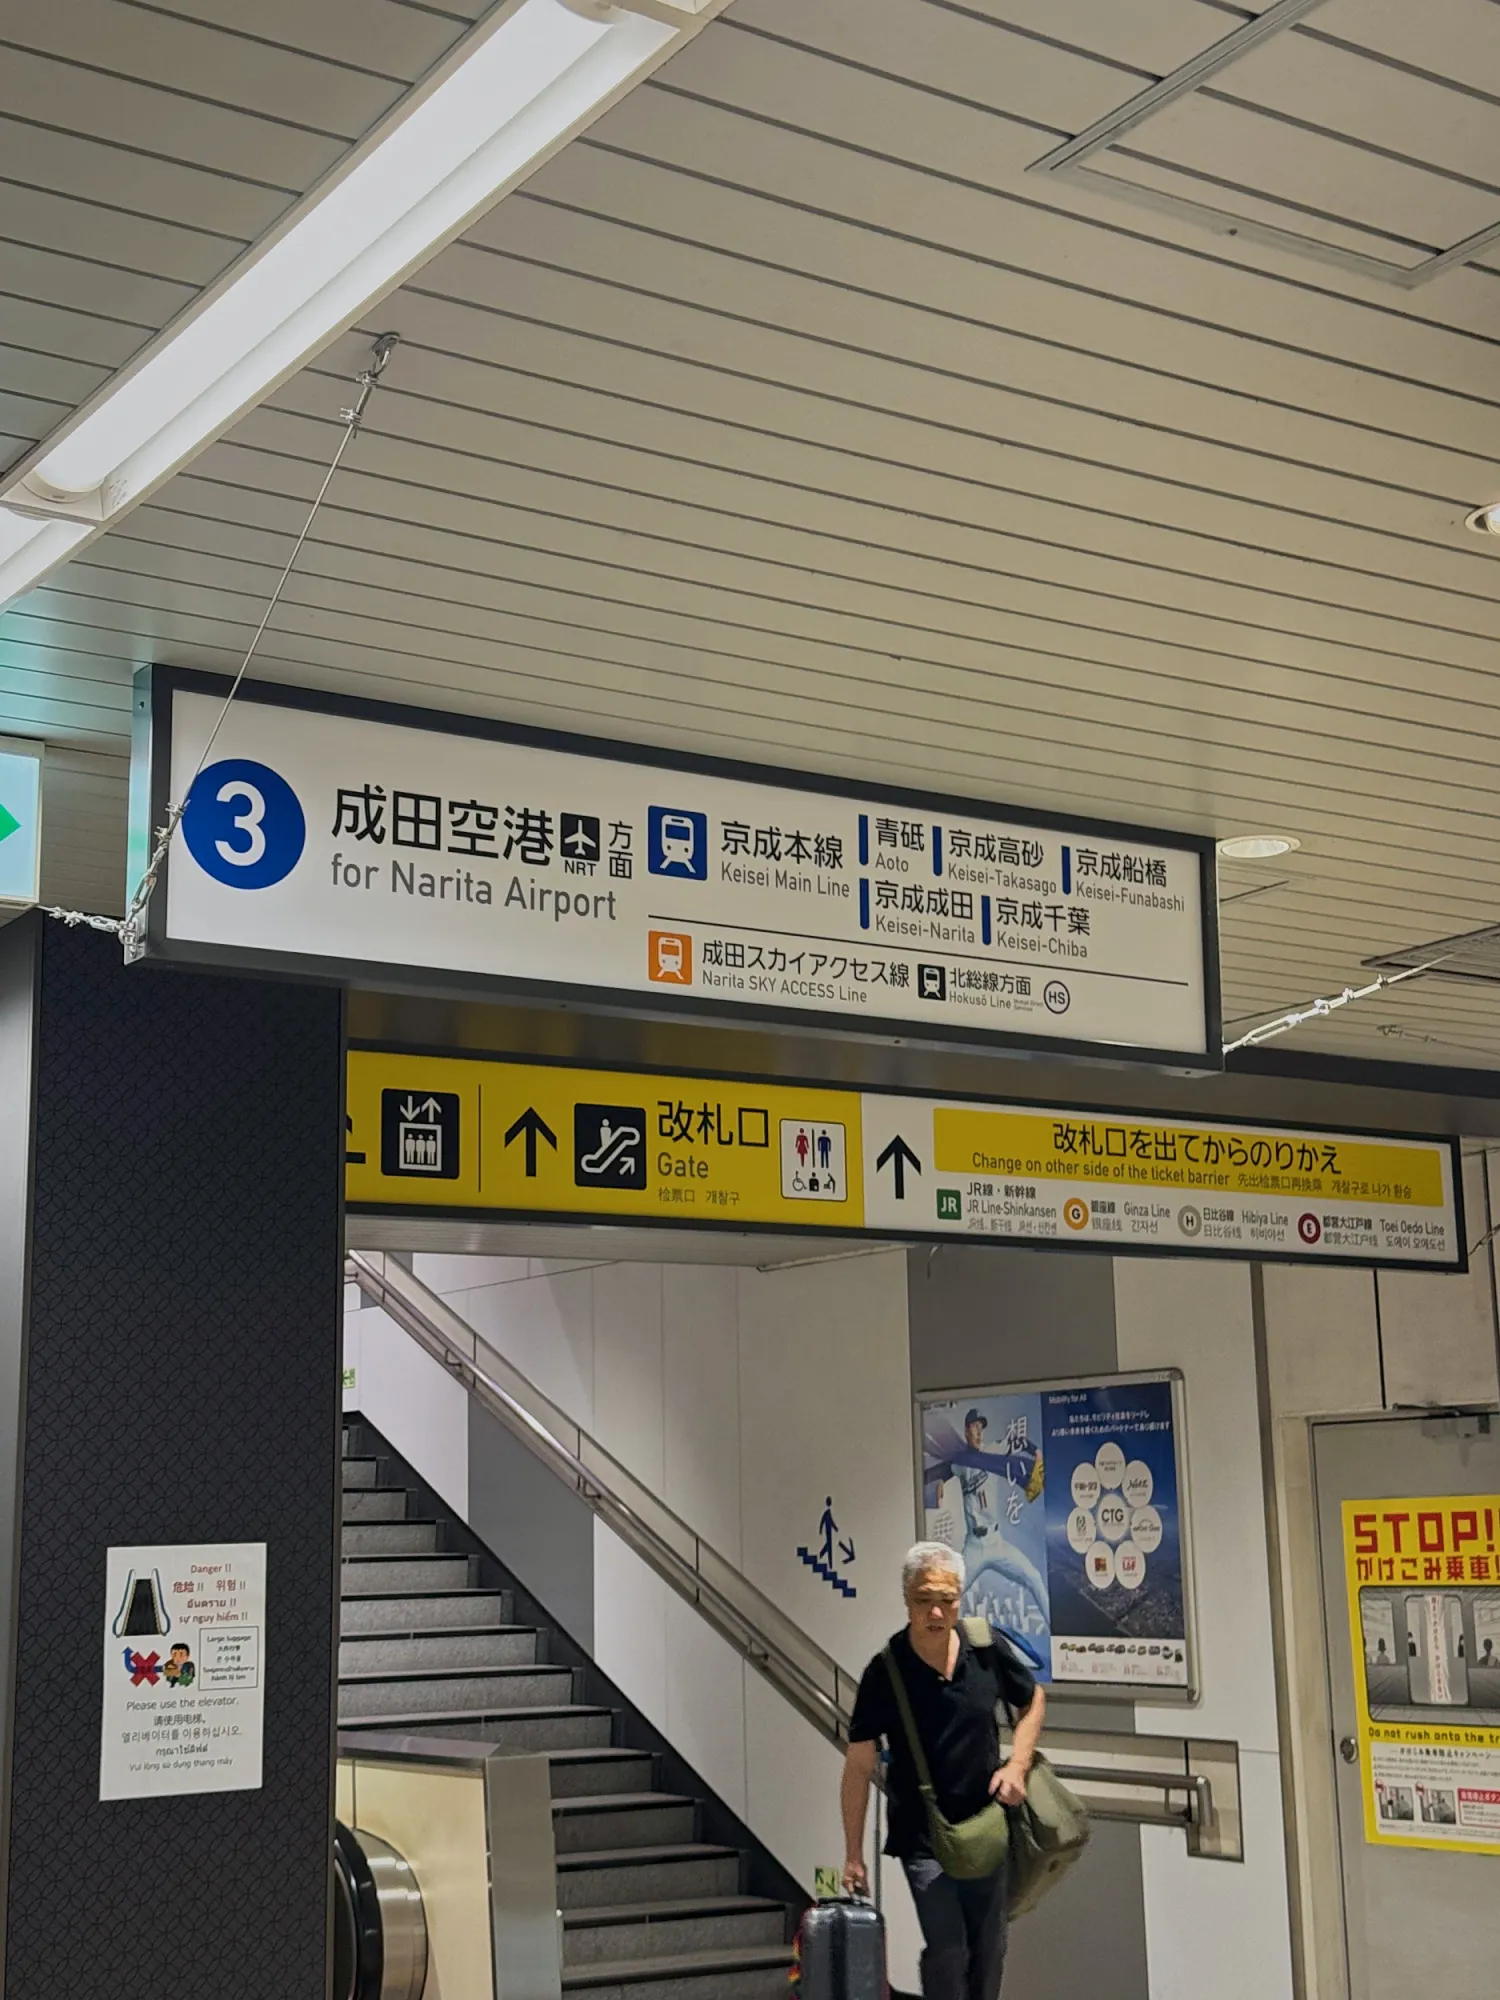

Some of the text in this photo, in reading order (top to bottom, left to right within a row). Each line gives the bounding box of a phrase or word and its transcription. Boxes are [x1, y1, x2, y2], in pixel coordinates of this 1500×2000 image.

[214, 780, 266, 866] 3
[332, 784, 554, 866] 成田空港
[875, 817, 925, 852] 青砥
[608, 820, 633, 879] 方面
[721, 821, 843, 870] 京成本線
[948, 829, 1044, 869] 京成高砂
[565, 859, 596, 877] NRT
[875, 852, 909, 872] Aoto
[1076, 847, 1167, 888] 京成船橋
[332, 853, 617, 922] for Narita Airport
[721, 861, 850, 897] Keisei Main Line
[948, 863, 1057, 896] Keisei-Takasago
[875, 880, 973, 920] 京成成田
[1076, 881, 1185, 912] Keisei-Funabashi
[875, 915, 975, 944] Keisei-Narita
[996, 897, 1090, 936] 京成千葉
[997, 931, 1087, 958] Keisei-Chiba
[702, 940, 910, 988] 成田スカイアクセス線
[702, 970, 867, 1003] Narita SKY ACCESS Line
[950, 967, 1031, 996] 北総線方面
[990, 996, 1011, 1009] Line
[1048, 991, 1066, 1005] HS
[657, 1100, 769, 1147] 改札口
[1053, 1123, 1341, 1174] 改札口を出てからのりかえ
[657, 1152, 709, 1179] Gate
[972, 1152, 1230, 1187] Change on other side of the ticket barrier
[940, 1196, 958, 1214] JR
[967, 1199, 979, 1213] JR
[1071, 1208, 1080, 1220] G
[1124, 1201, 1170, 1218] Ginza Line
[1203, 1207, 1234, 1222] 日比谷線
[1242, 1210, 1289, 1227] Hibiya Line
[1186, 1215, 1194, 1227] H
[1380, 1219, 1444, 1236] Toei Oedo Line
[1101, 1508, 1124, 1523] CTG
[1353, 1508, 1500, 1554] STOP!
[191, 1564, 223, 1575] Danger
[192, 1615, 214, 1624] nguy
[126, 1700, 157, 1711] Please
[160, 1700, 177, 1709] use
[179, 1698, 196, 1708] the
[1368, 1726, 1381, 1738] Do
[1384, 1729, 1401, 1739] not
[1405, 1730, 1430, 1740] rush
[1434, 1731, 1460, 1742] onto
[1464, 1732, 1484, 1743] the
